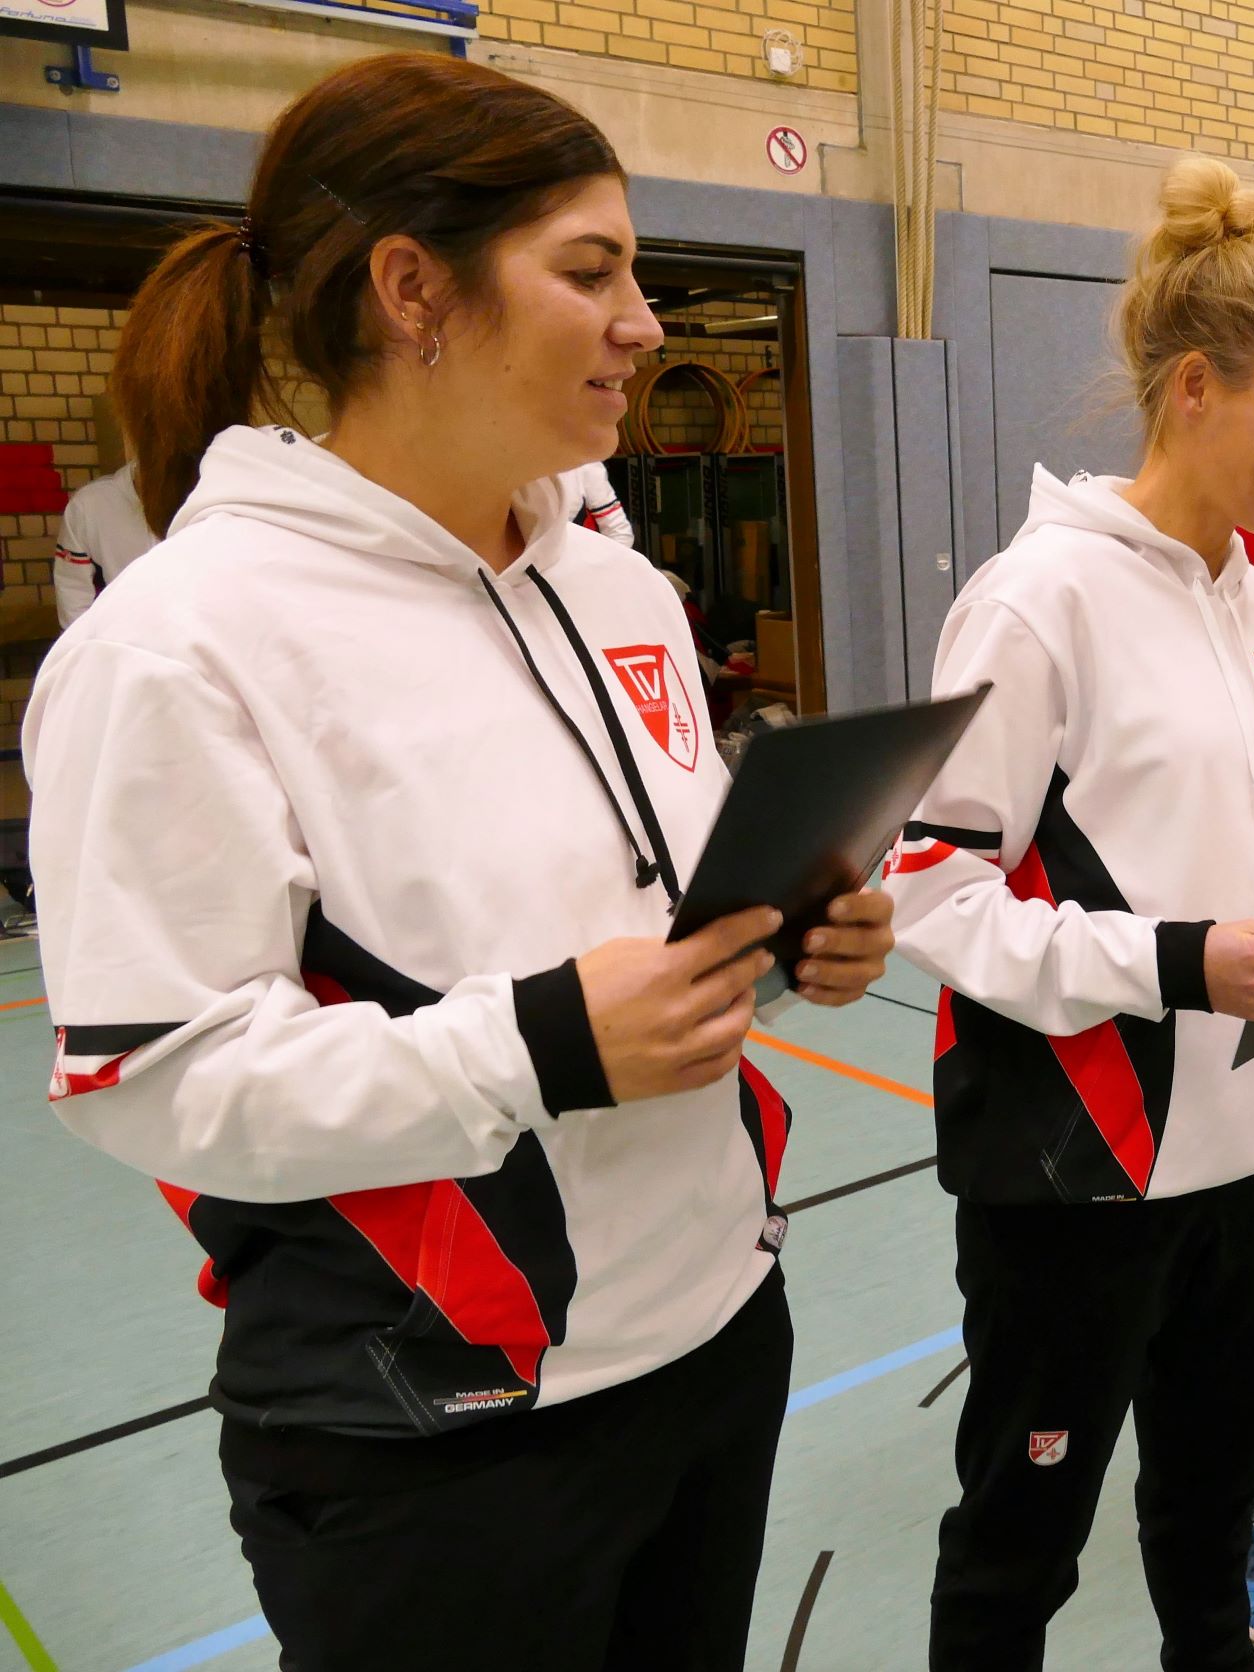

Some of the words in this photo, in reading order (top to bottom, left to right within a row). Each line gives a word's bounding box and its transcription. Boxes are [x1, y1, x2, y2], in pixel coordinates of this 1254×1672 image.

[613, 654, 662, 701] TV
[455, 1389, 484, 1399] MADE
[445, 1397, 514, 1413] GERMANY
[1033, 1434, 1060, 1448] TV
